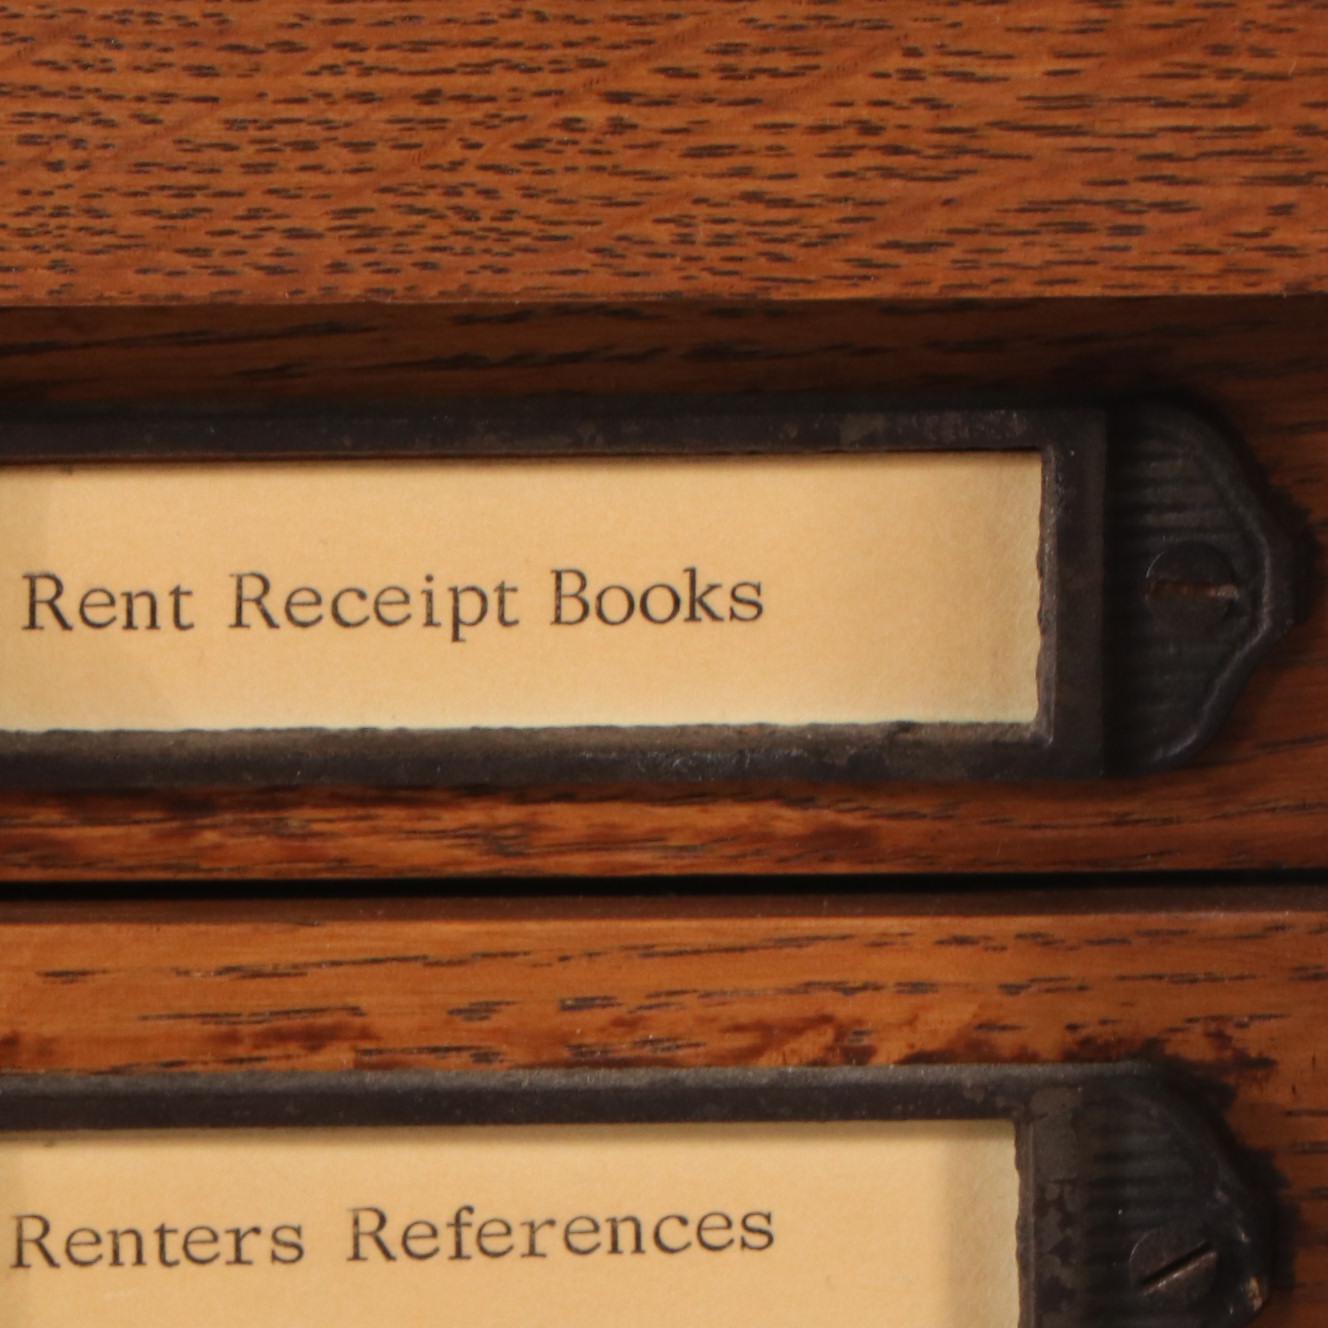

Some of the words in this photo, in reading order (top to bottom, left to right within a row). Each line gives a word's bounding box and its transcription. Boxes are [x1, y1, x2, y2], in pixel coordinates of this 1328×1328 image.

[22, 571, 195, 632] Rent
[229, 572, 520, 643] Receipt
[551, 566, 765, 626] Books
[10, 1213, 305, 1270] Renters
[347, 1205, 776, 1263] References
